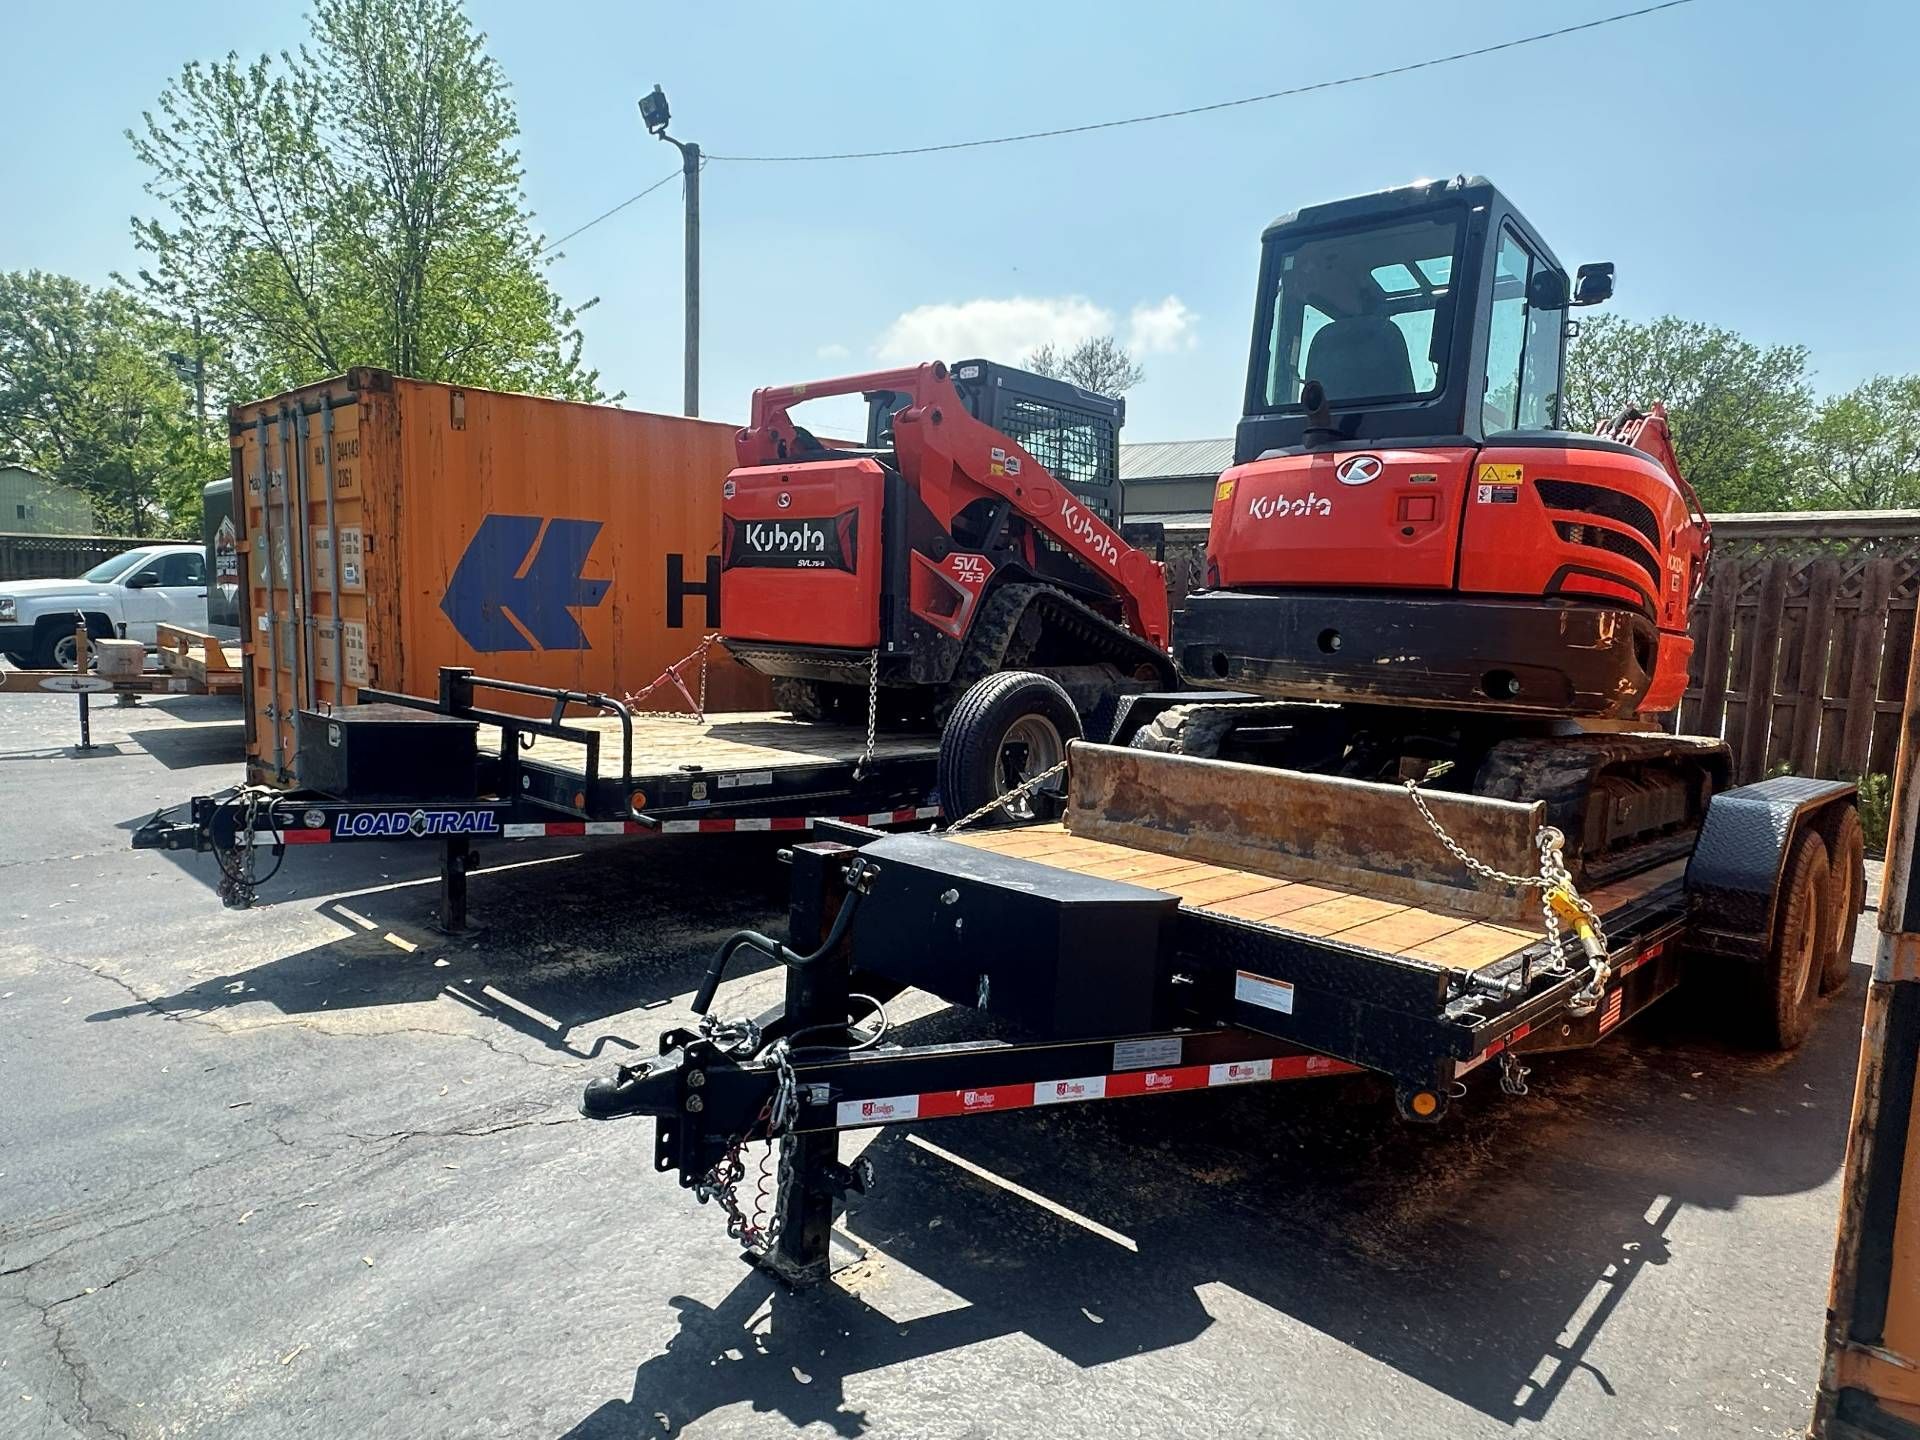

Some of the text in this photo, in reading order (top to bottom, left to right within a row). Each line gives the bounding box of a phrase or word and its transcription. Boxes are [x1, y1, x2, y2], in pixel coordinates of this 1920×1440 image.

[1249, 492, 1332, 519] Kubota
[746, 522, 825, 552] Kubota
[1061, 499, 1118, 566] Kubota
[952, 556, 983, 571] SVL
[958, 571, 985, 583] 75-3
[336, 812, 412, 837] LOAD
[424, 811, 500, 833] TRAIL
